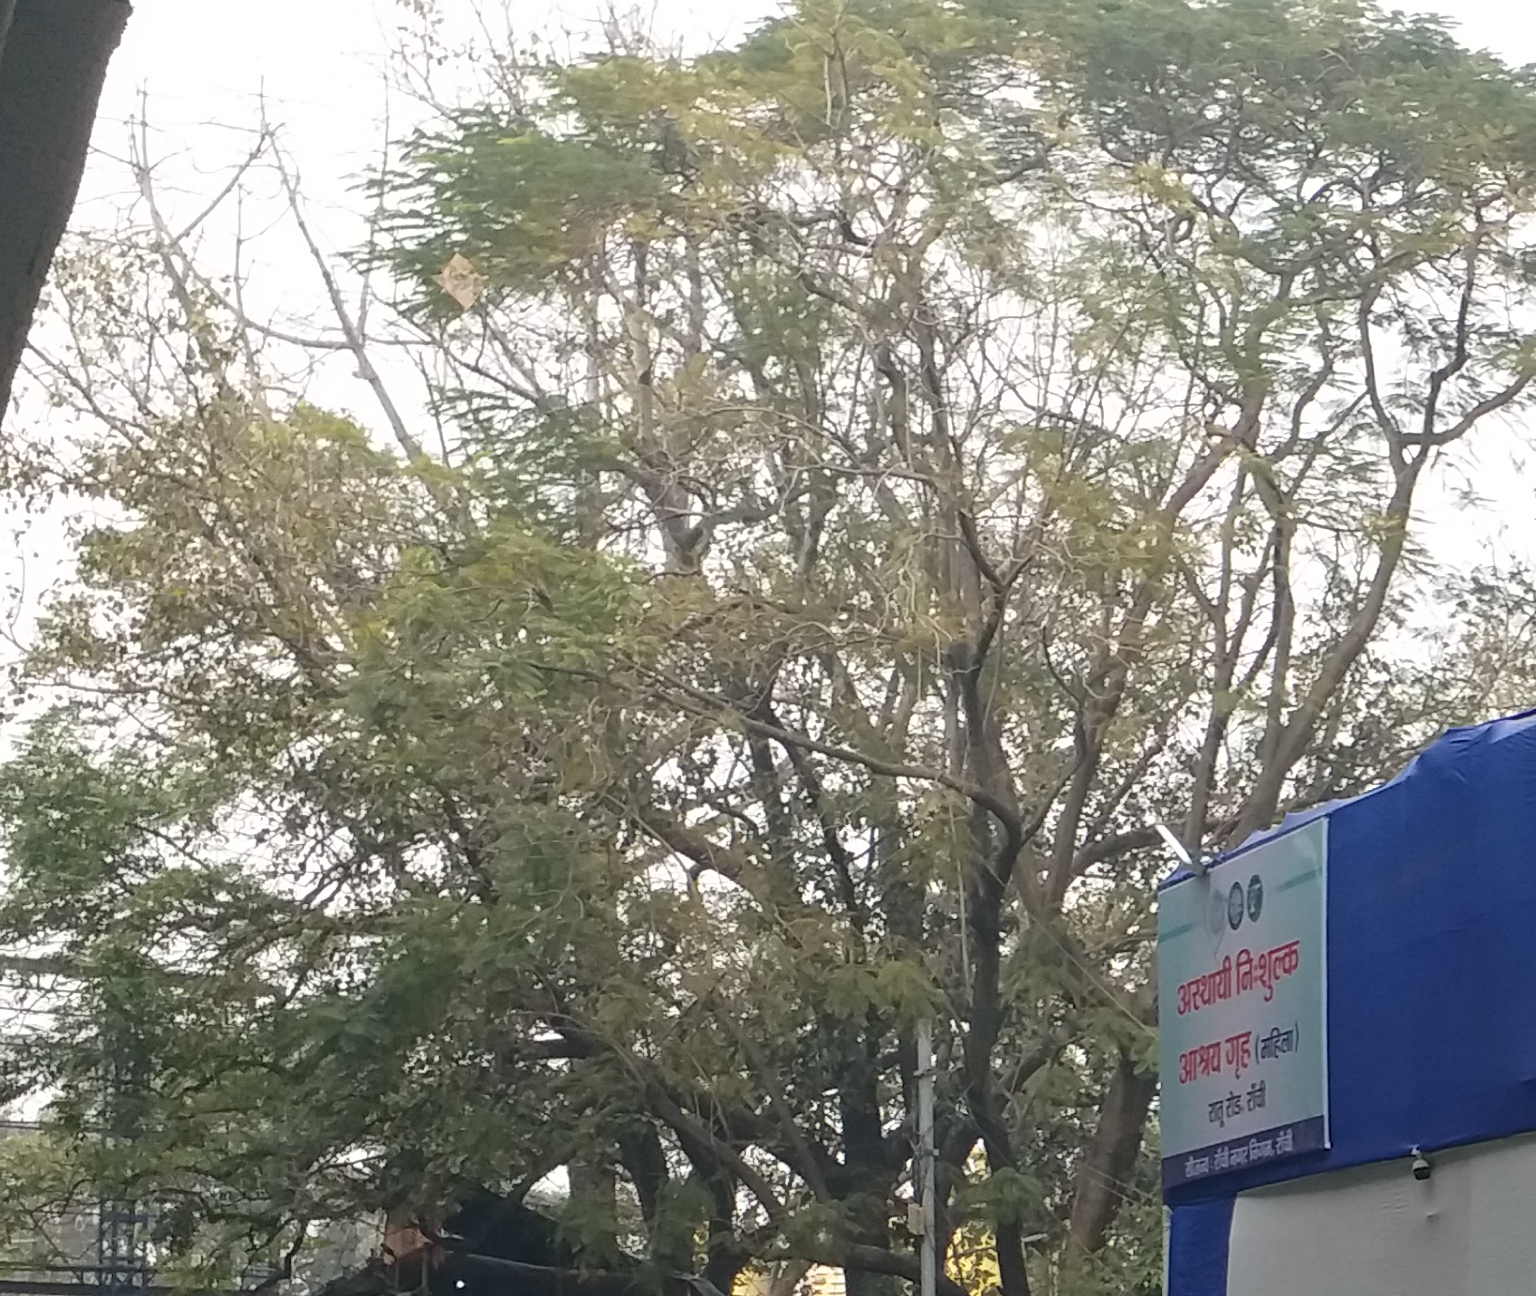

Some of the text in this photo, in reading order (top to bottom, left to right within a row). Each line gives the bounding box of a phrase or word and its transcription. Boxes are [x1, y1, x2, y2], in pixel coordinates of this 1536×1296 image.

[1177, 955, 1232, 1015] अस्थायी
[1179, 1041, 1221, 1084] आश्रय
[1225, 1031, 1252, 1079] गृह
